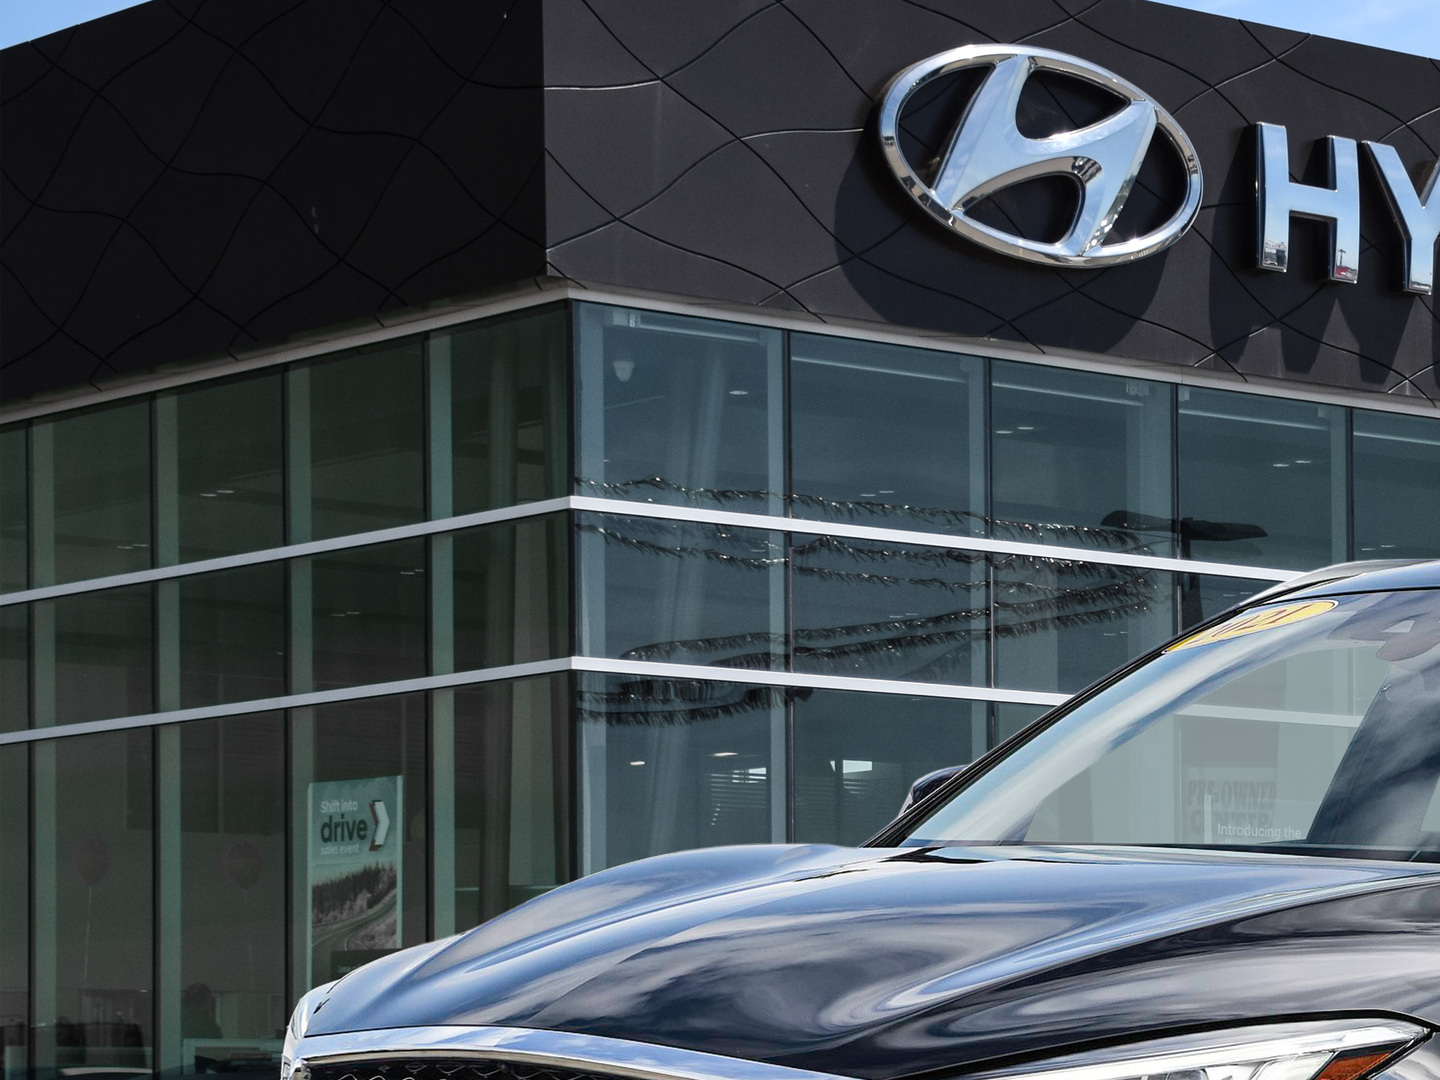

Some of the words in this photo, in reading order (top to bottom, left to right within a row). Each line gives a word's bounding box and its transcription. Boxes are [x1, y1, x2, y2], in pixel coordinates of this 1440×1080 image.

[340, 800, 358, 812] into
[320, 813, 368, 843] drive
[1190, 809, 1271, 835] CNTER
[1217, 823, 1281, 840] Introducing
[1283, 826, 1302, 839] the
